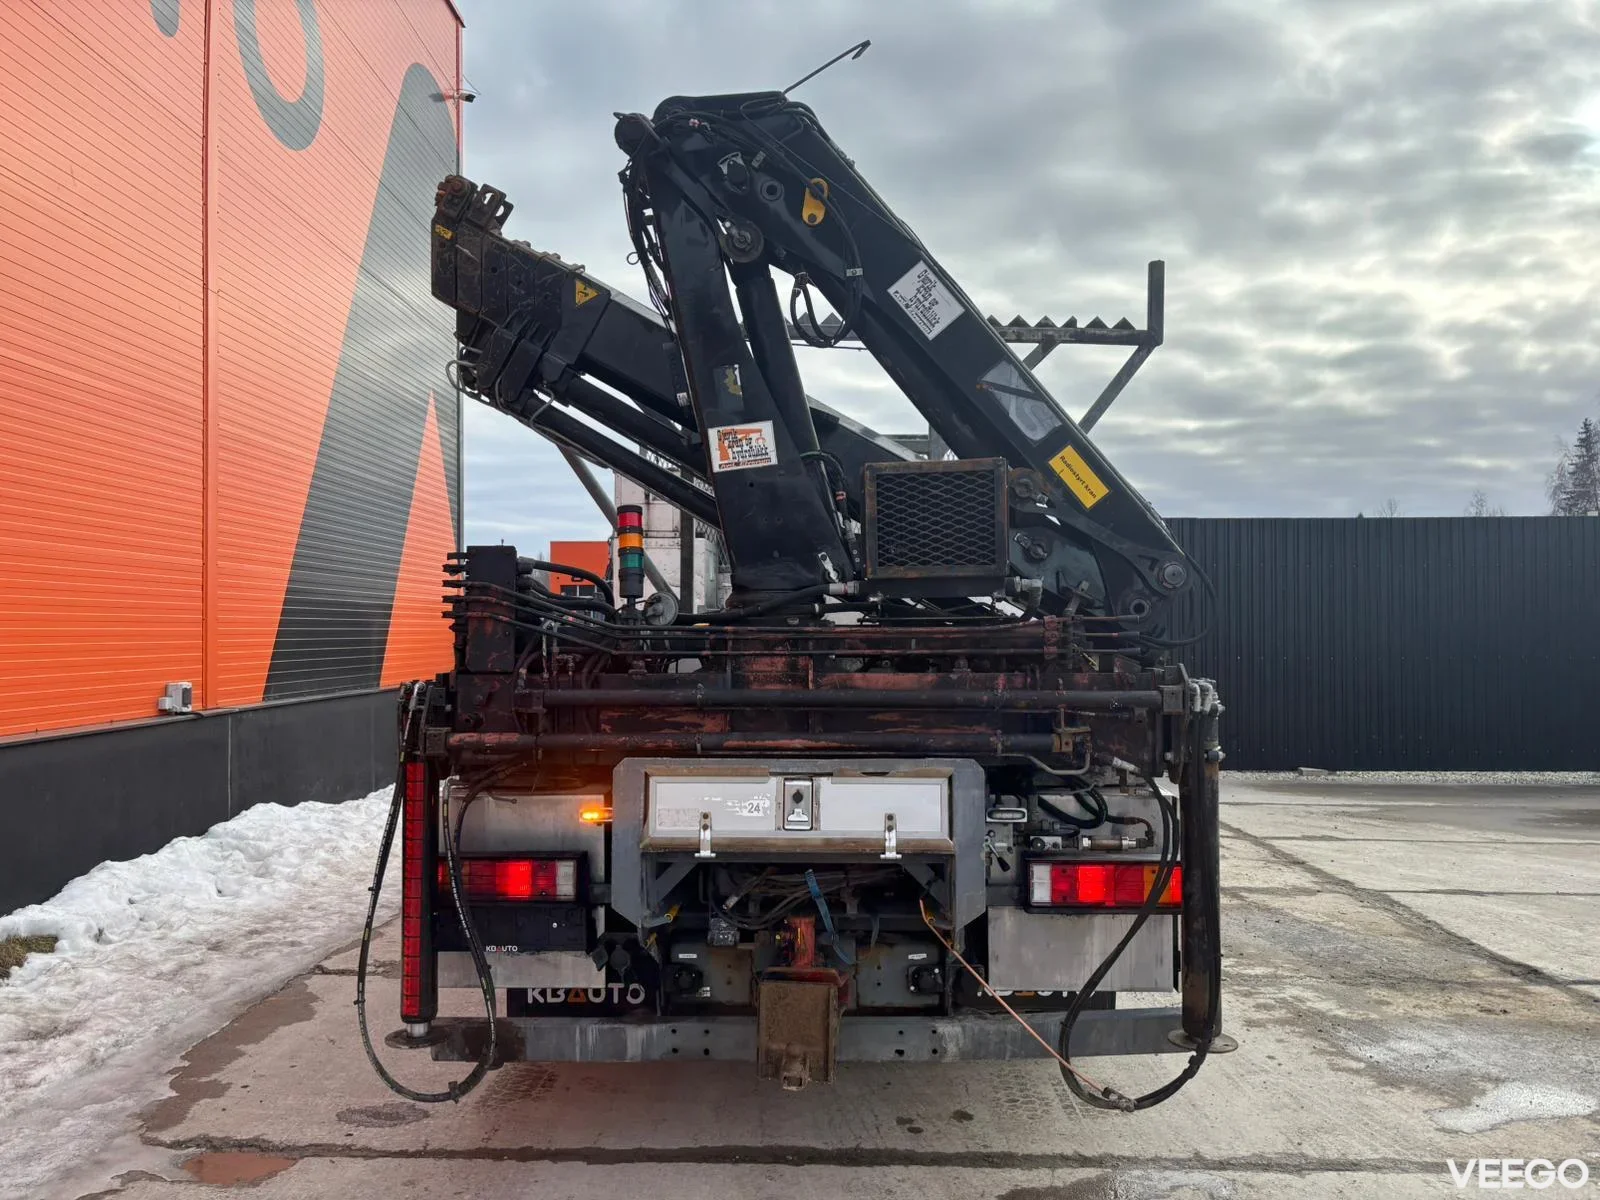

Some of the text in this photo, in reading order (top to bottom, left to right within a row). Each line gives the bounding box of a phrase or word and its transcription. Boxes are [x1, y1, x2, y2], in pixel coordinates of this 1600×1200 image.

[1060, 455, 1097, 499] Radiostyrt kran
[747, 802, 761, 814] 24
[527, 983, 646, 1004] KBAUTO
